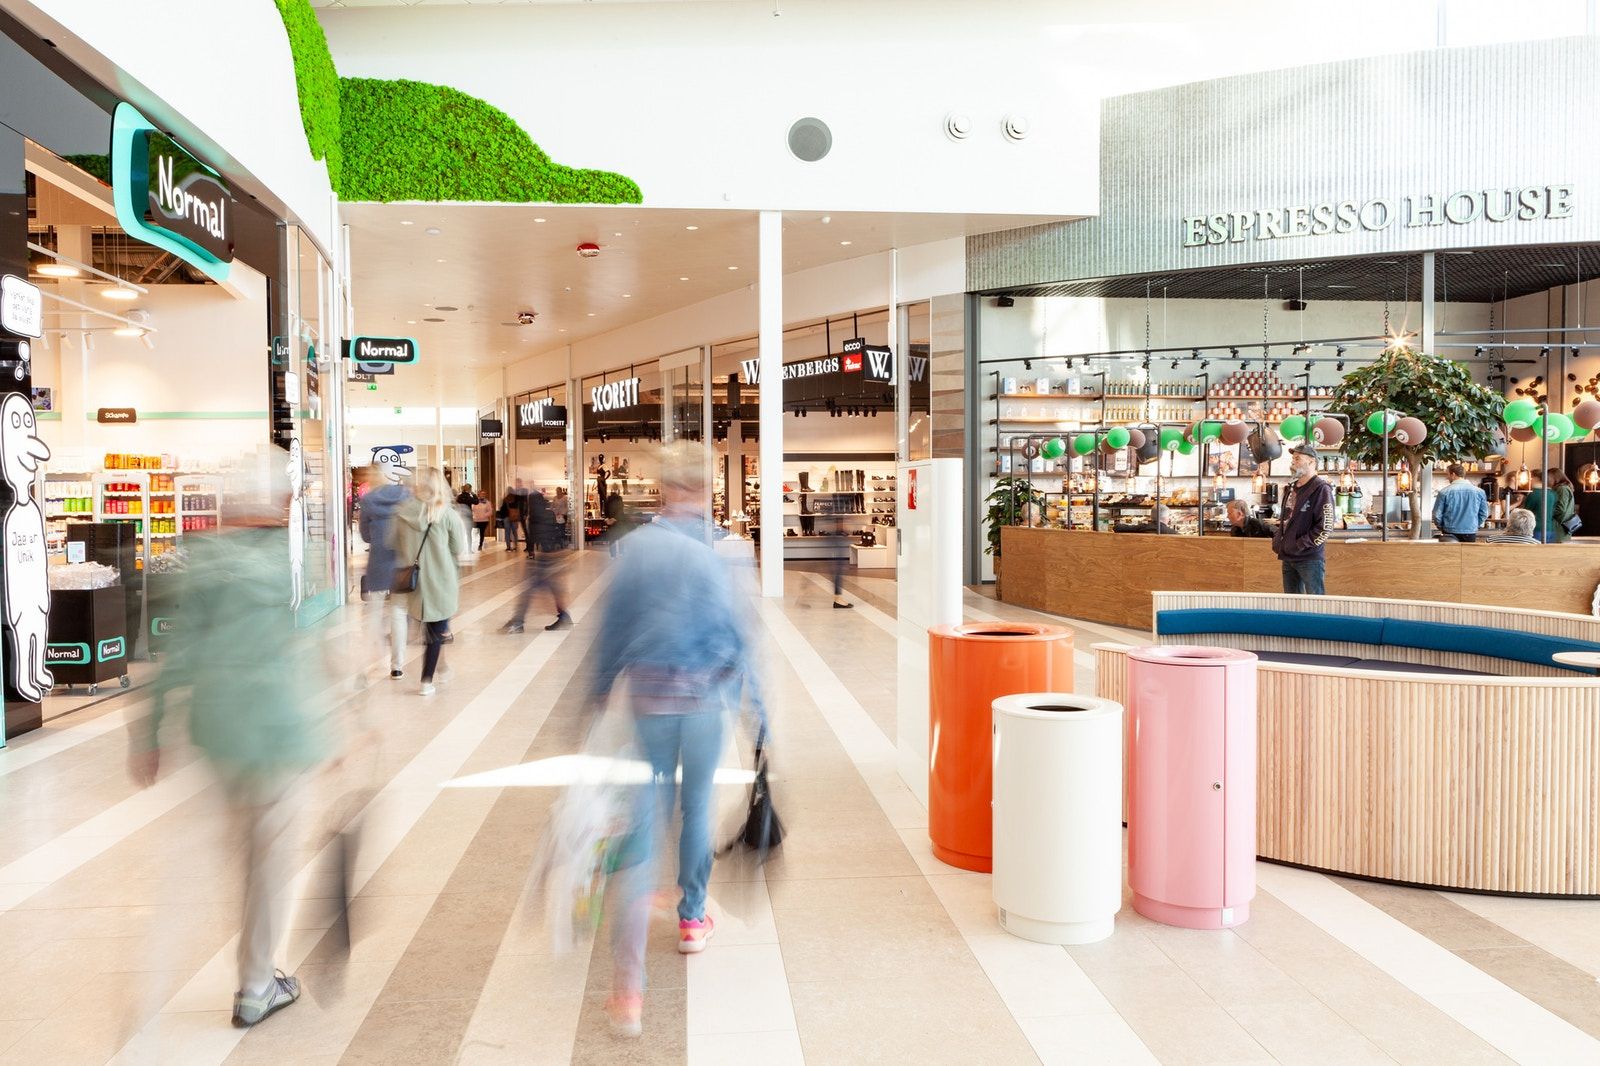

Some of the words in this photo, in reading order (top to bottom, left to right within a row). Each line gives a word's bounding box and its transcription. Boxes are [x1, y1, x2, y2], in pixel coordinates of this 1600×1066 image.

[158, 154, 225, 240] Normal
[1183, 197, 1396, 247] ESPRESSO
[1405, 183, 1575, 227] HOUSE
[360, 341, 408, 357] Normal
[844, 342, 861, 352] ecco
[866, 349, 890, 379] W.
[591, 377, 639, 413] SCORETT
[11, 531, 27, 546] Jag
[47, 648, 80, 659] Normal
[103, 643, 120, 656] Normal
